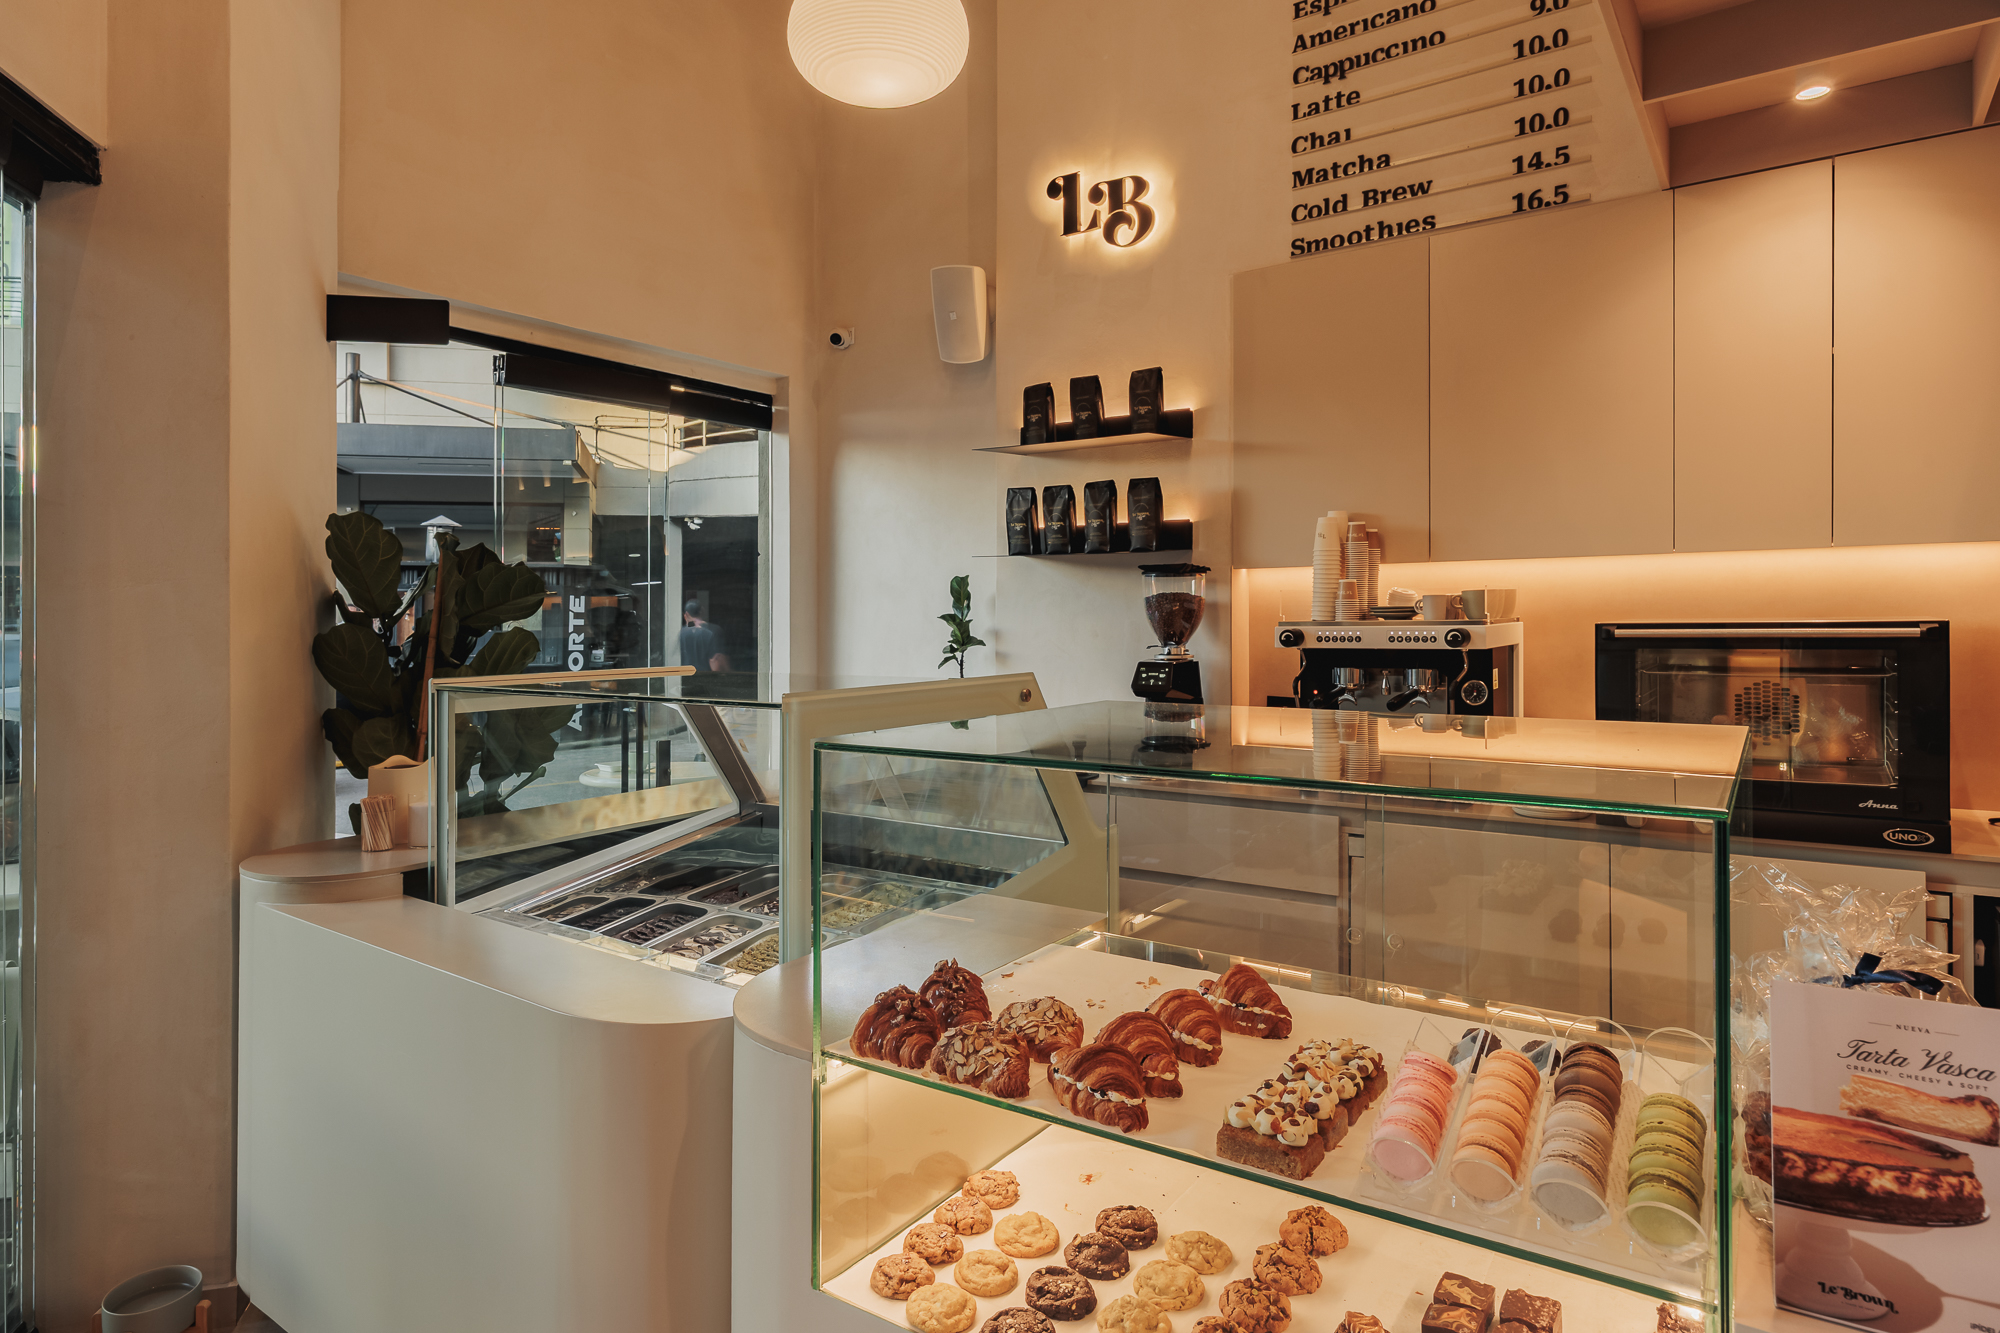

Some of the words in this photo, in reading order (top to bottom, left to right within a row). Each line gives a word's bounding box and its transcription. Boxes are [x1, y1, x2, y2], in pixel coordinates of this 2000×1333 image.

[1292, 0, 1350, 21] Esp
[1292, 0, 1437, 55] Americano
[1291, 90, 1361, 121] Latte
[1513, 28, 1569, 60] 10.0
[1292, 30, 1447, 85] Cappuccino
[1291, 128, 1352, 154] Chai
[1513, 68, 1571, 98] 10.0
[1291, 154, 1392, 189] Matcha
[1514, 107, 1570, 137] 10.0
[1046, 171, 1155, 247] LB
[1291, 193, 1348, 223] Cold
[1362, 180, 1433, 209] Brew
[1512, 145, 1571, 175] 14.5
[1290, 215, 1437, 257] Smoothies
[1512, 184, 1570, 213] 16.5
[1858, 799, 1899, 810] Anna
[1895, 1023, 1931, 1034] NUEVA
[1836, 1039, 1910, 1068] Tarta
[1919, 1048, 1997, 1082] Vasca
[1899, 1072, 1941, 1085] CHEESY
[1960, 1082, 1989, 1092] SOFT
